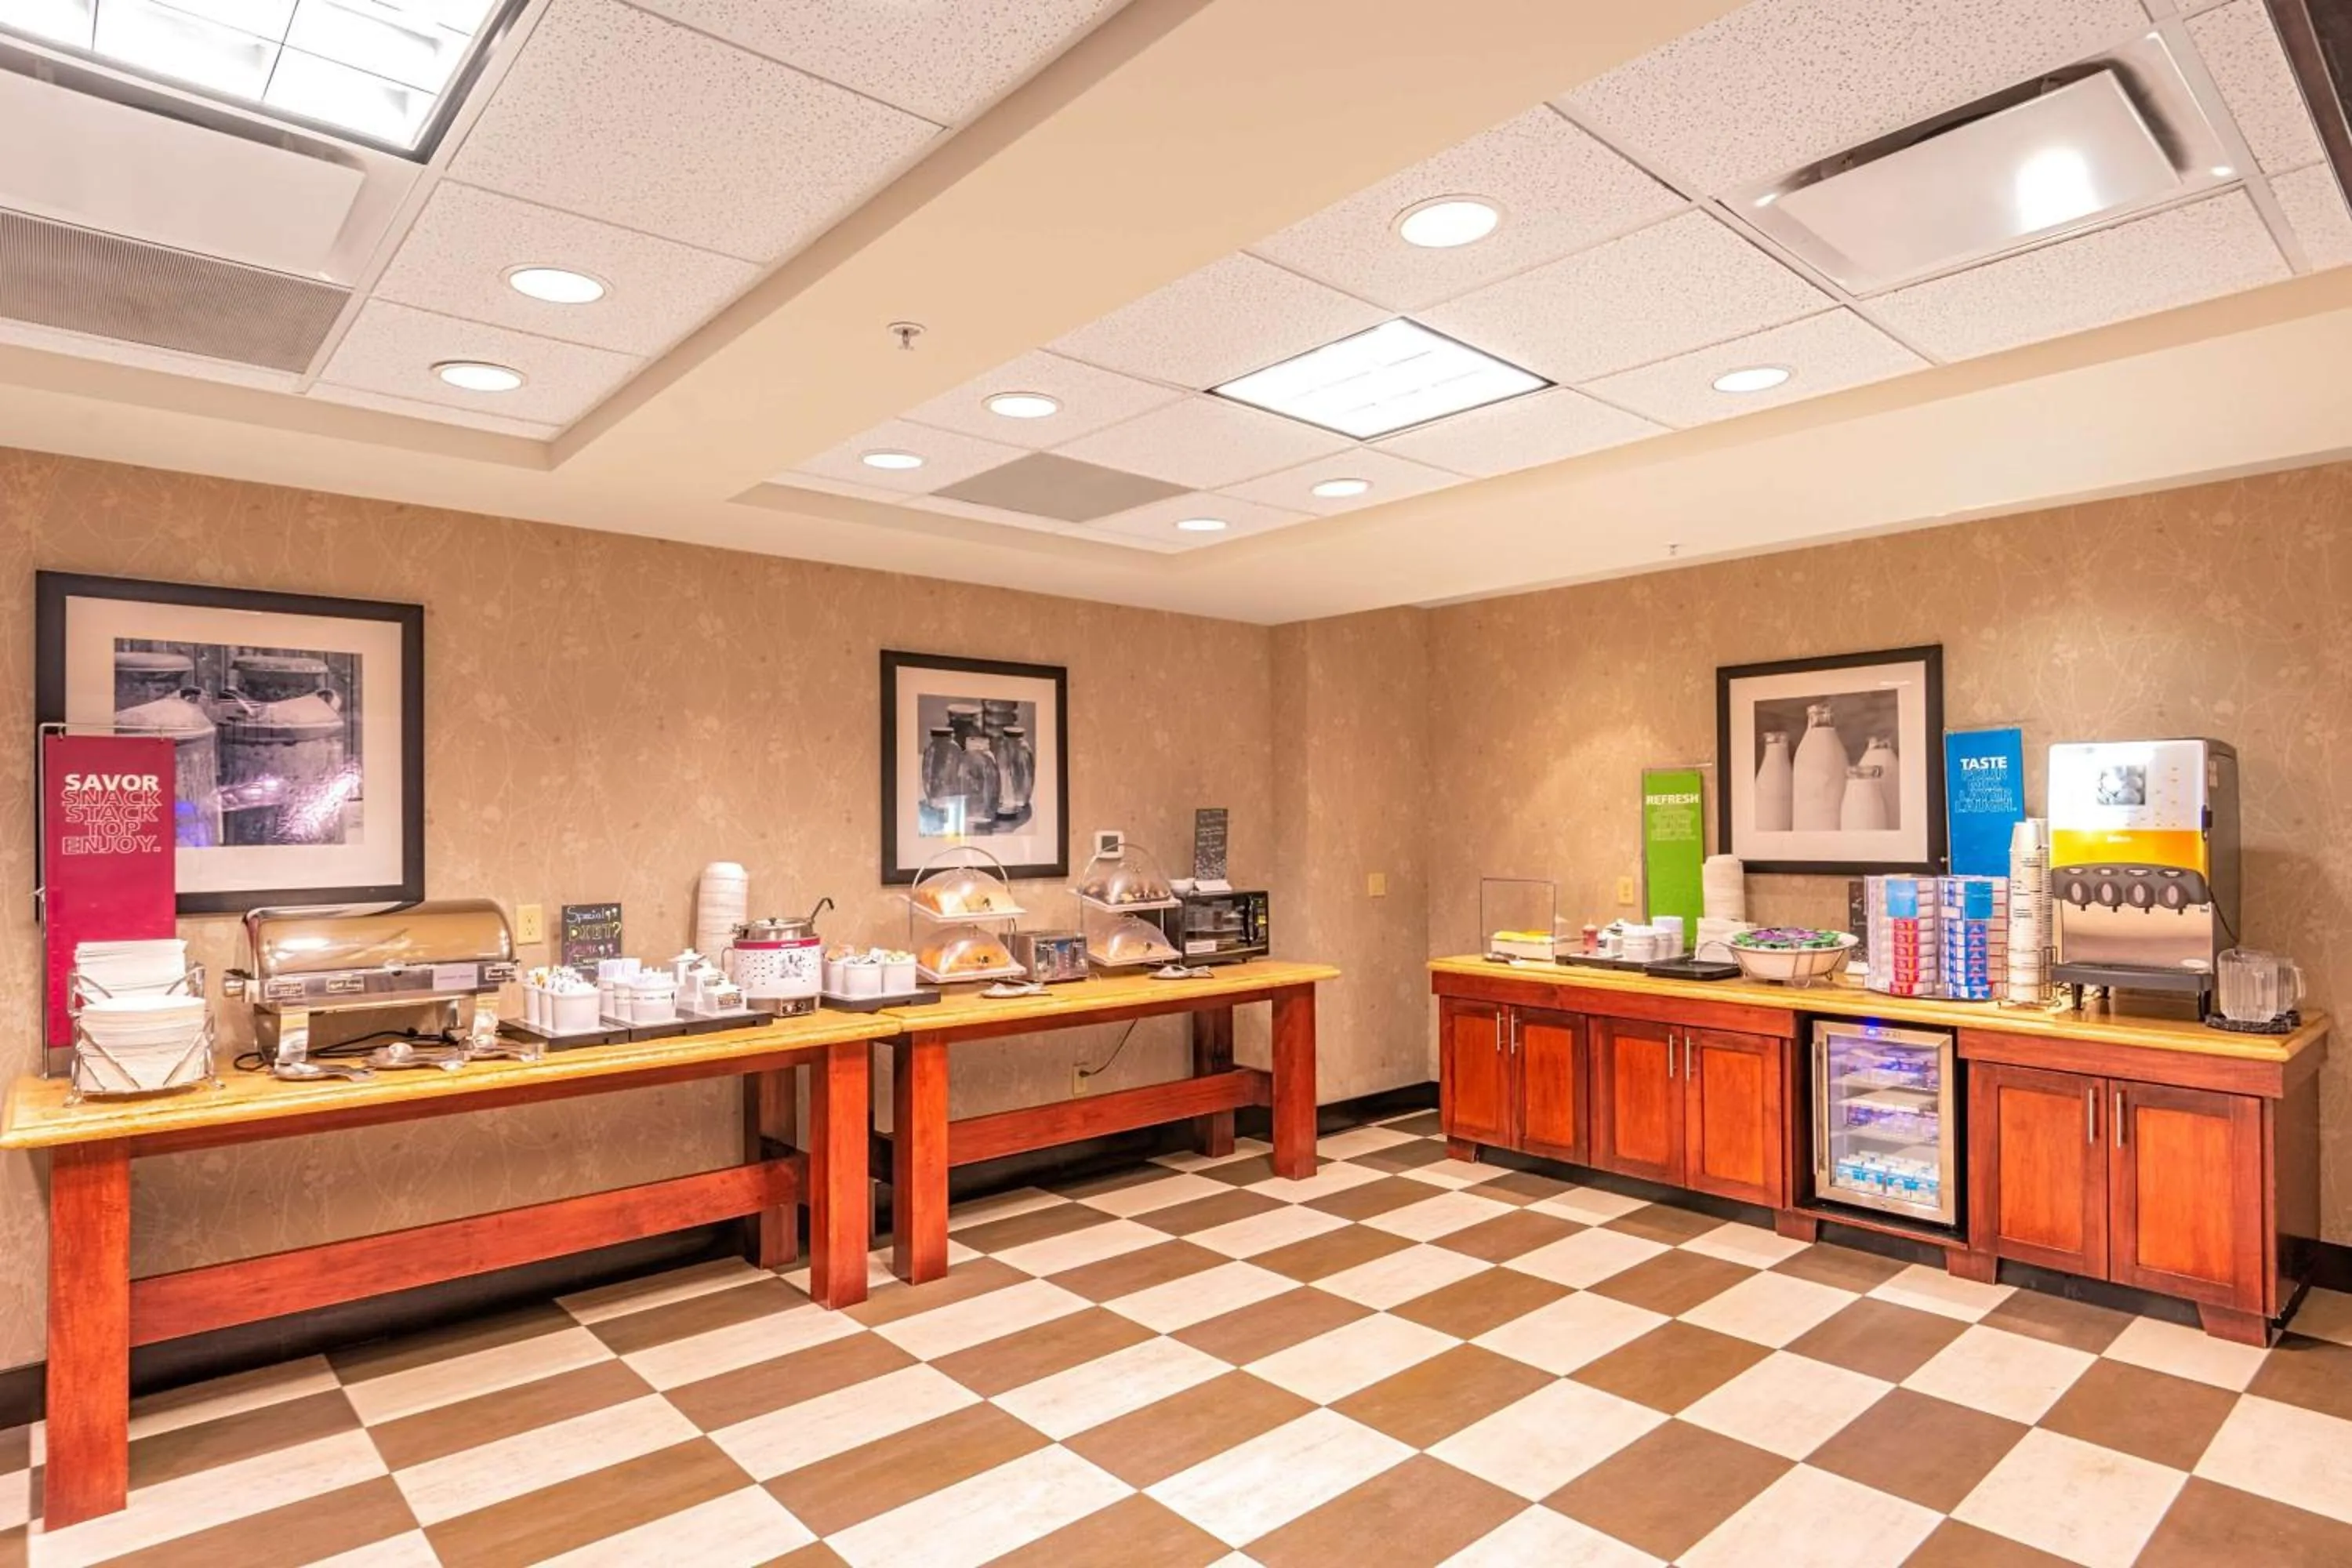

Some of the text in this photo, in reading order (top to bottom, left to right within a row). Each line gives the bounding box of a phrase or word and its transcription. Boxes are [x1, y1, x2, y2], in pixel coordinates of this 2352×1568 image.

[1960, 757, 2008, 770] TASTE
[64, 775, 158, 791] SAVOR
[61, 789, 162, 807] SNACK
[1646, 793, 1700, 805] REFRESH
[66, 804, 158, 822] STACK
[85, 821, 141, 838] TOP
[62, 836, 162, 855] ENJOY.
